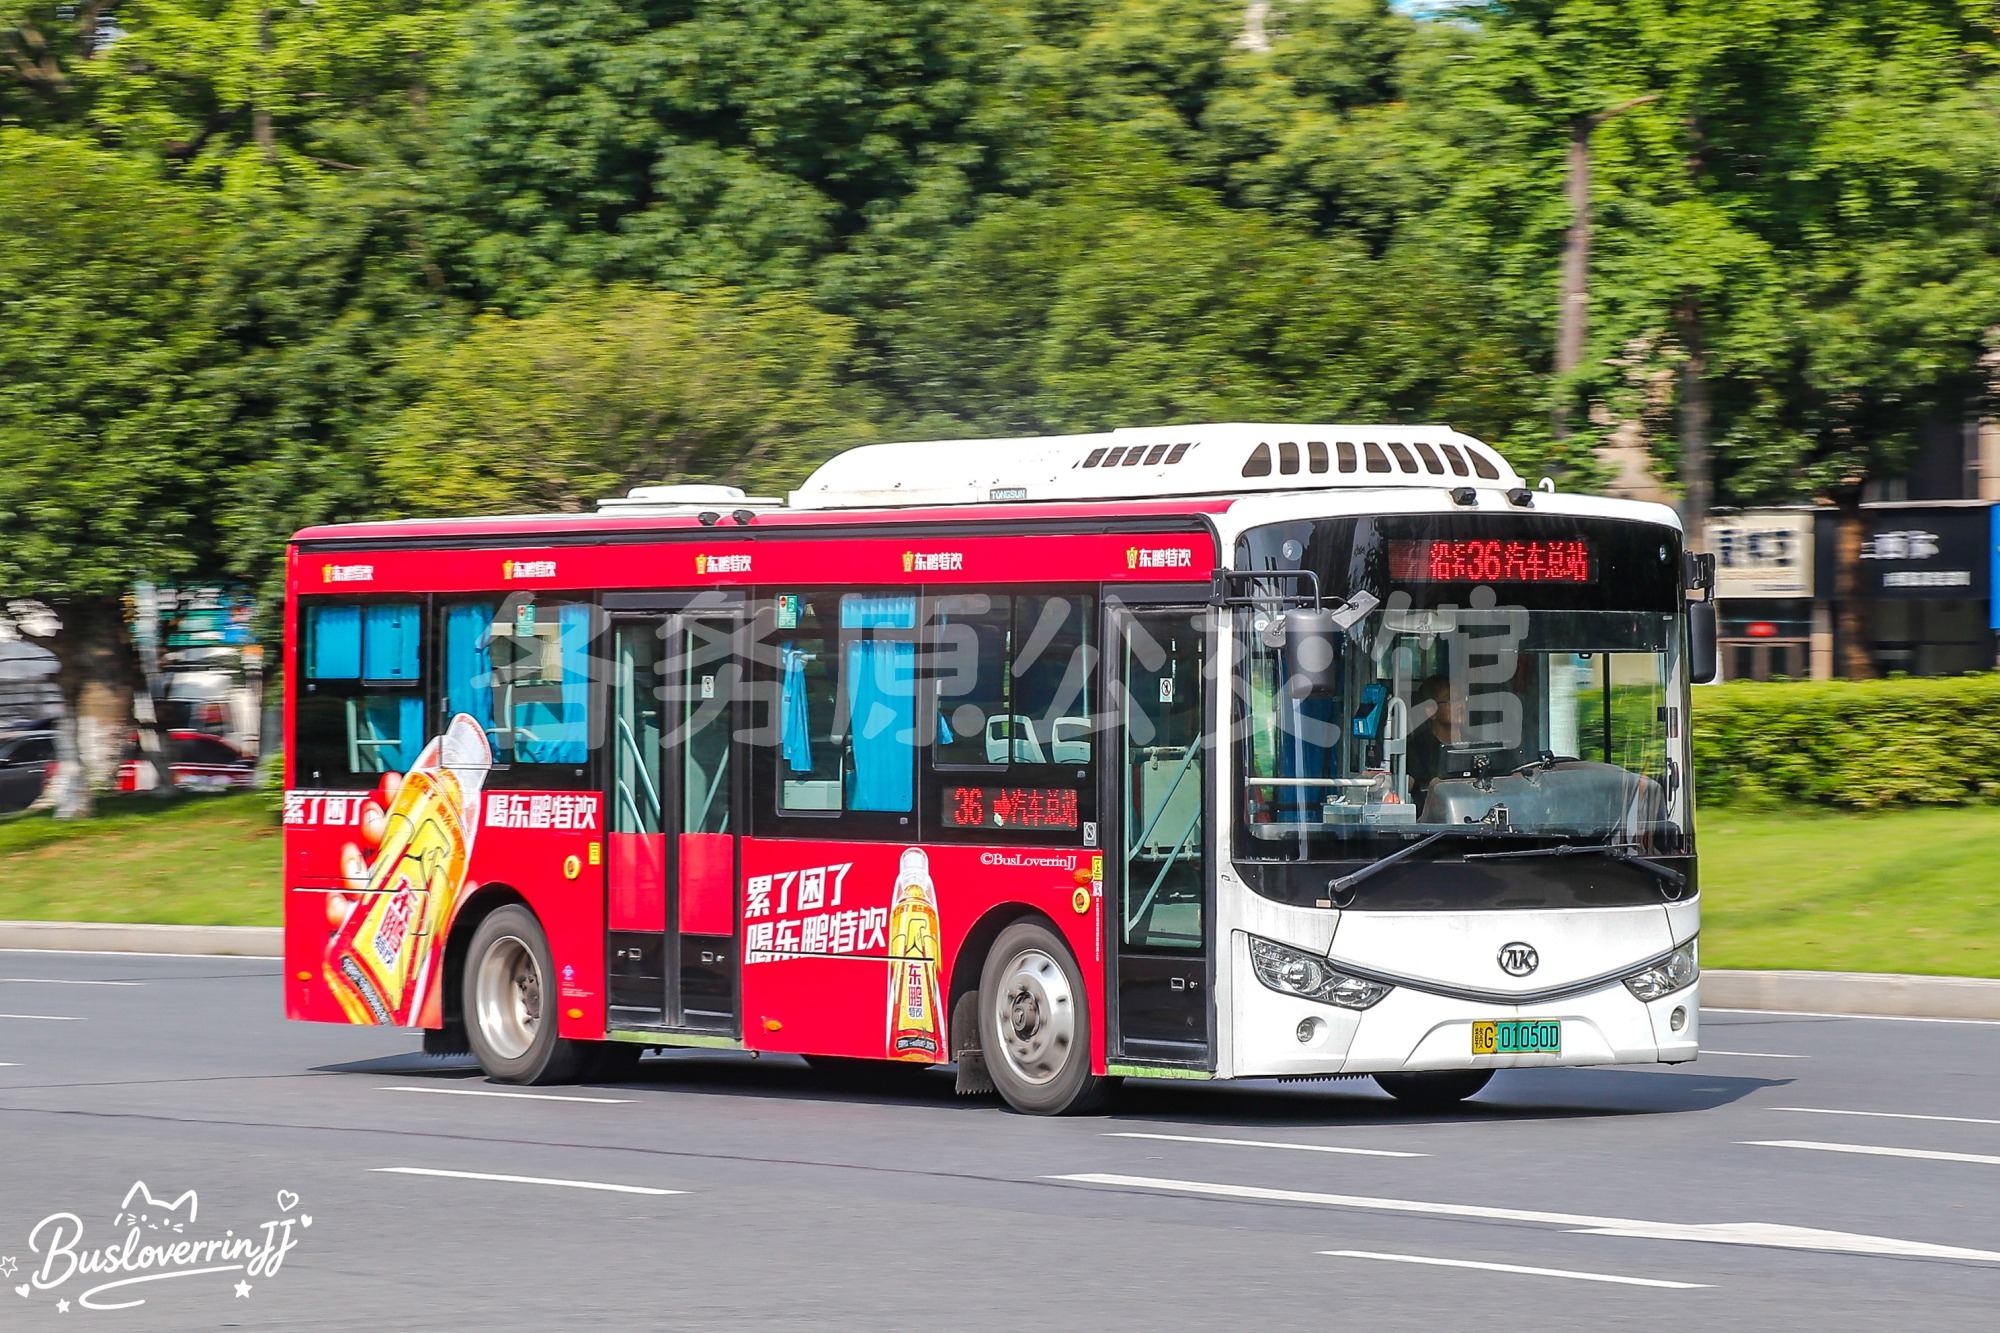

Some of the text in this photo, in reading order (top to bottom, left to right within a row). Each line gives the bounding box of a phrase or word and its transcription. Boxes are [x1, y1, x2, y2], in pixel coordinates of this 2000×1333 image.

[707, 554, 752, 573] 东鹏特饮
[914, 551, 963, 570] 东鹏特饮
[1139, 547, 1192, 567] 东鹏特饮
[1467, 541, 1501, 580] 36
[1505, 542, 1588, 581] 汽车总站
[485, 794, 598, 829] 喝东鹏特饮
[954, 787, 1077, 827] 36 汽车总站
[744, 862, 853, 918] 累了困了
[745, 906, 887, 965] 喝东鹏特饮
